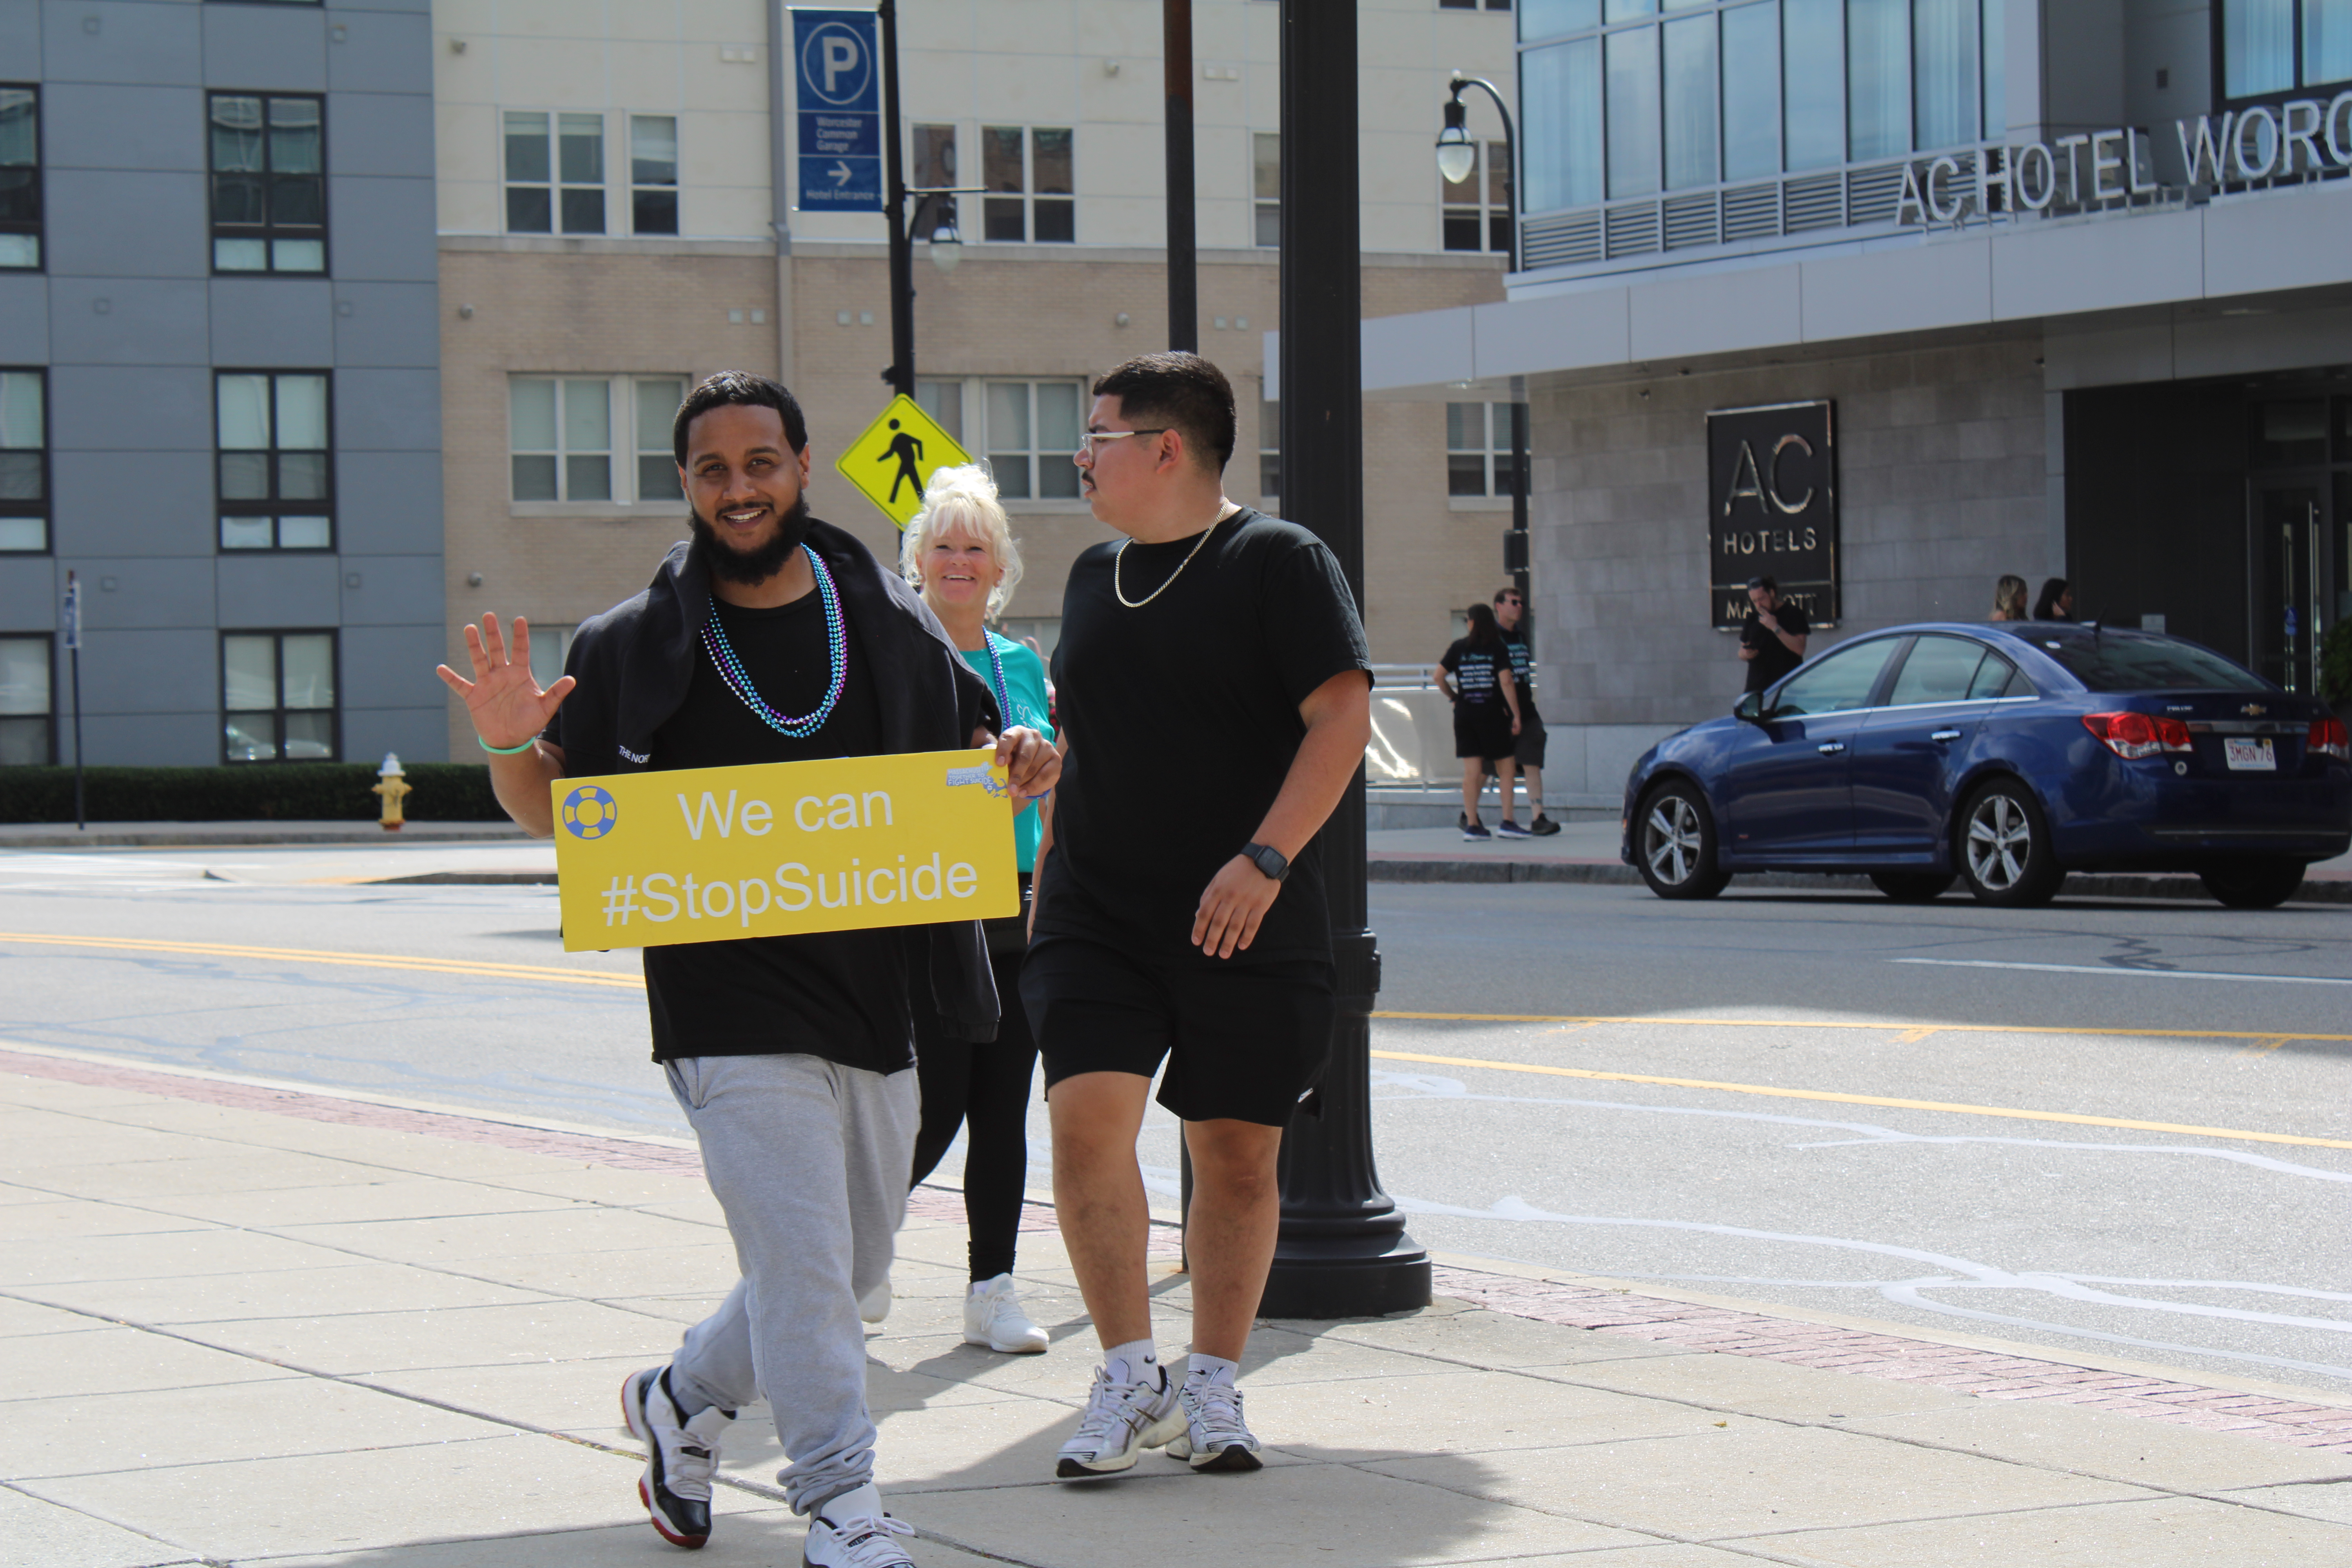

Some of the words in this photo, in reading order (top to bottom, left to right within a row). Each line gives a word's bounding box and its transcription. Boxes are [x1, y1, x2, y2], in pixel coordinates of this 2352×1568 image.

[822, 36, 858, 91] P
[817, 129, 858, 139] Common
[817, 140, 849, 153] Garage
[1896, 157, 1962, 226] AC
[1977, 127, 2157, 212] HOTEL
[1725, 434, 1814, 516] AC
[1725, 527, 1816, 554] HOTELS
[619, 745, 632, 759] THE
[948, 778, 970, 786] FIGHT
[970, 776, 994, 785] SUICIDE
[677, 789, 773, 840] We
[793, 790, 894, 832] can
[601, 851, 978, 928] #StopSuicide
